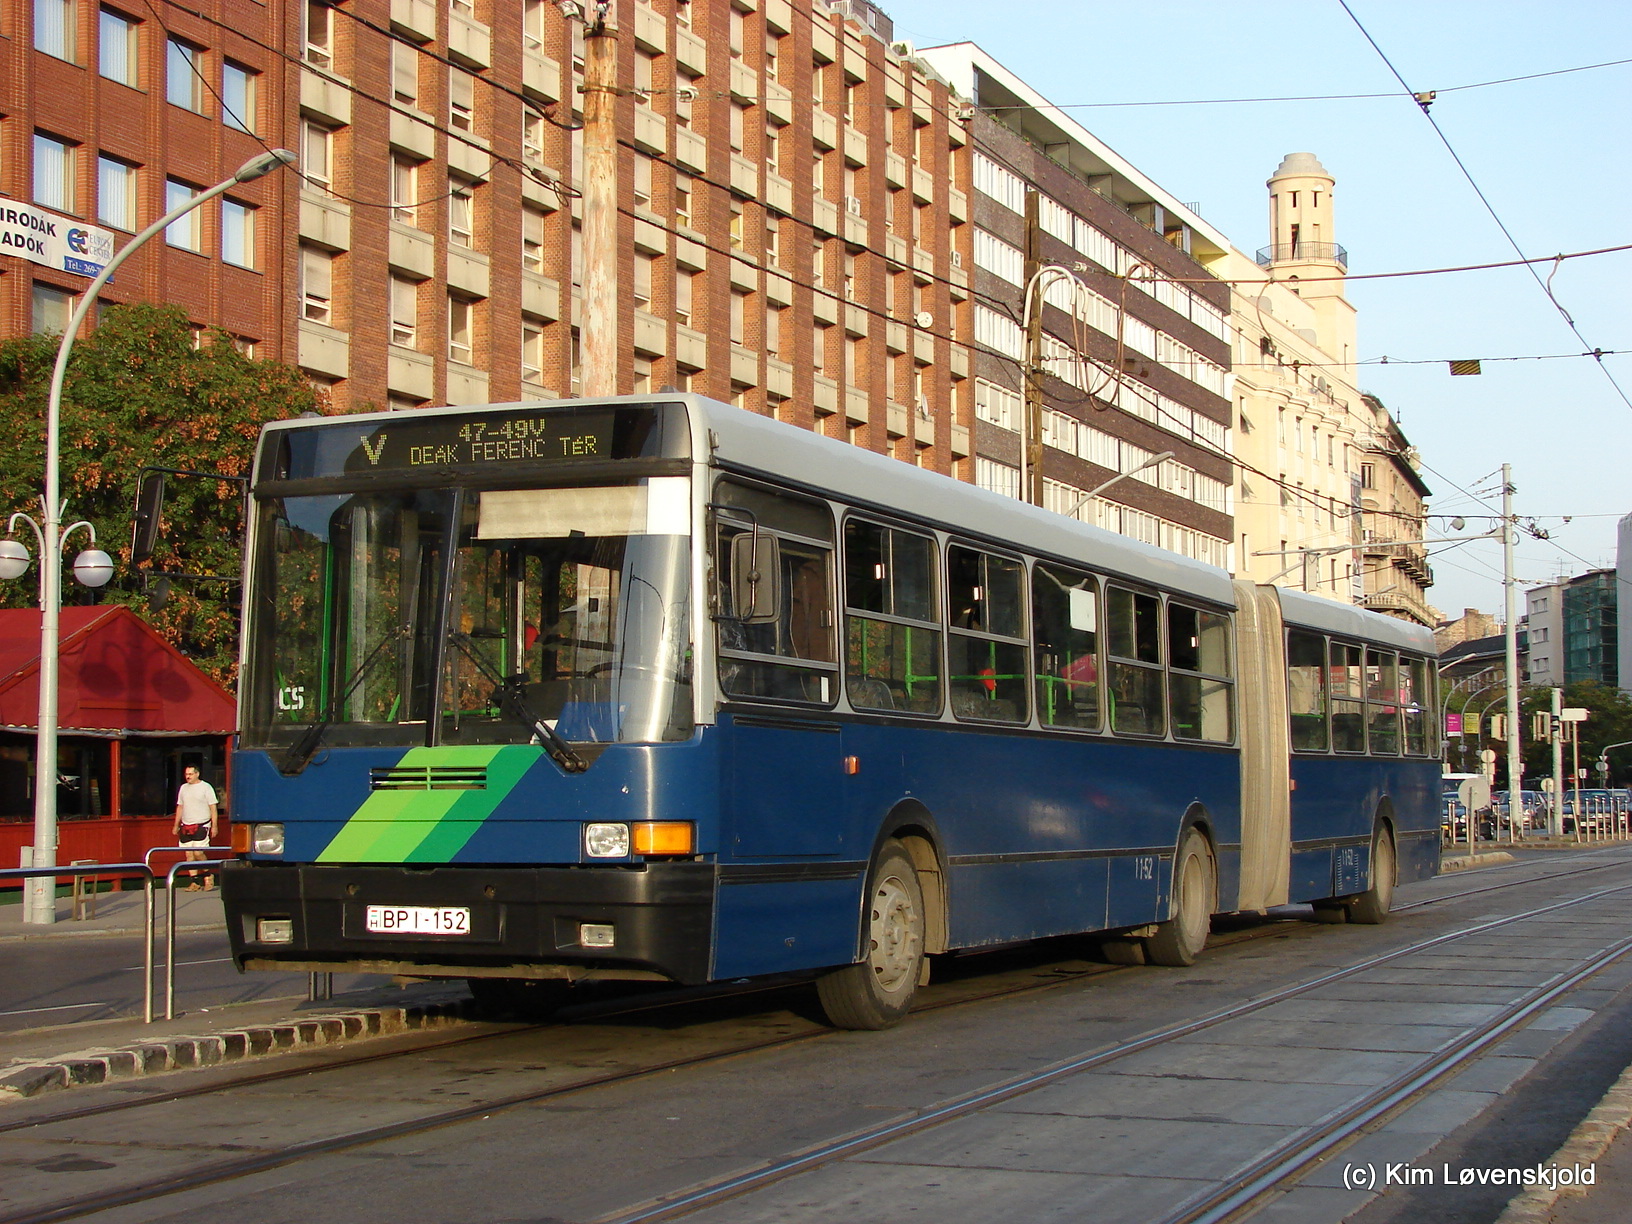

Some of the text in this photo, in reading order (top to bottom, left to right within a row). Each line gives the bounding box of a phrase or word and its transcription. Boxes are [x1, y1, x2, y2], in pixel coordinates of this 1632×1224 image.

[0, 207, 57, 238] IRODÁK
[2, 231, 45, 256] ADÓK
[459, 418, 545, 441] 47-49V
[360, 434, 387, 465] V
[410, 435, 597, 465] DEÁK FERENC TÉR
[370, 910, 465, 930] H BPI-152
